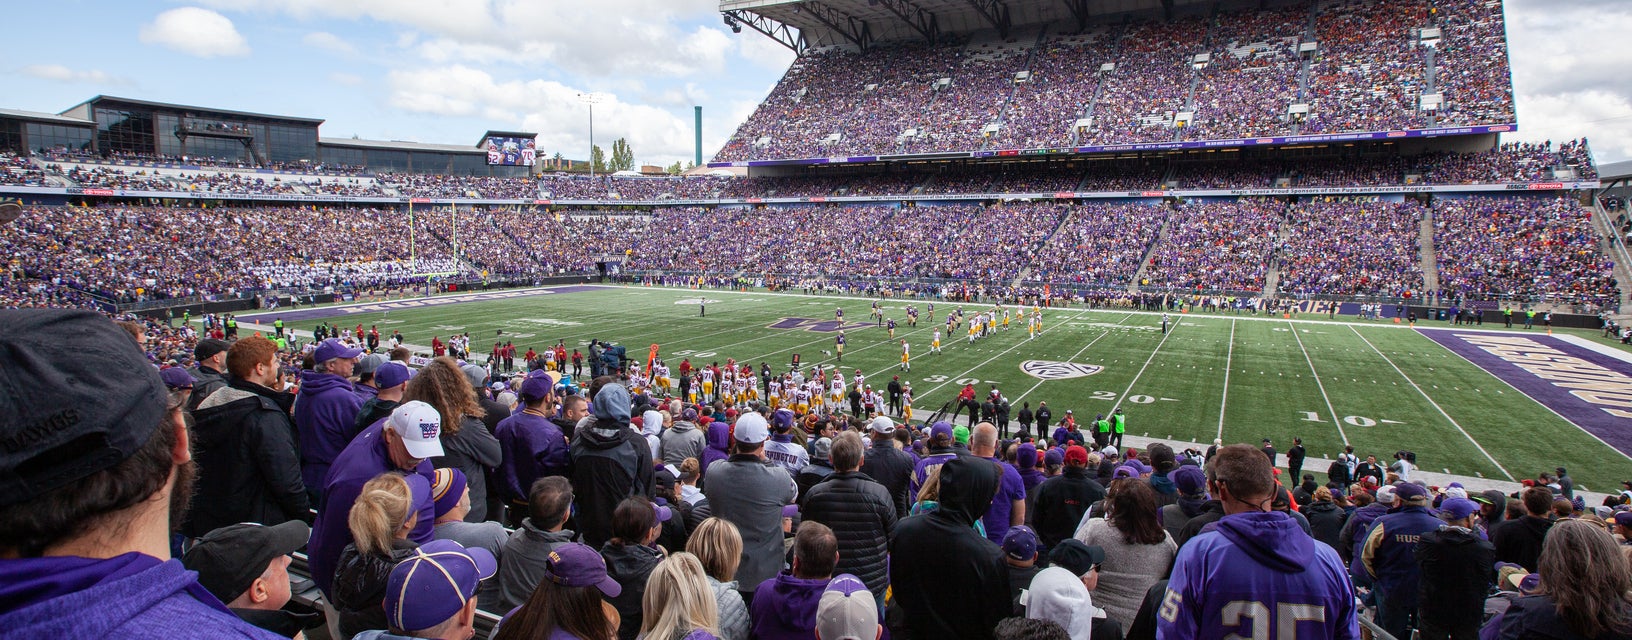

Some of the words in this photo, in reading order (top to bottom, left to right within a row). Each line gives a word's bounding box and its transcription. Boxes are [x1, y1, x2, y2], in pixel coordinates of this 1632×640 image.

[523, 151, 533, 161] 70
[923, 373, 981, 386] 30
[1088, 390, 1156, 404] 20
[1298, 410, 1377, 427] 10
[2, 408, 81, 455] DAWGS
[419, 422, 439, 439] W
